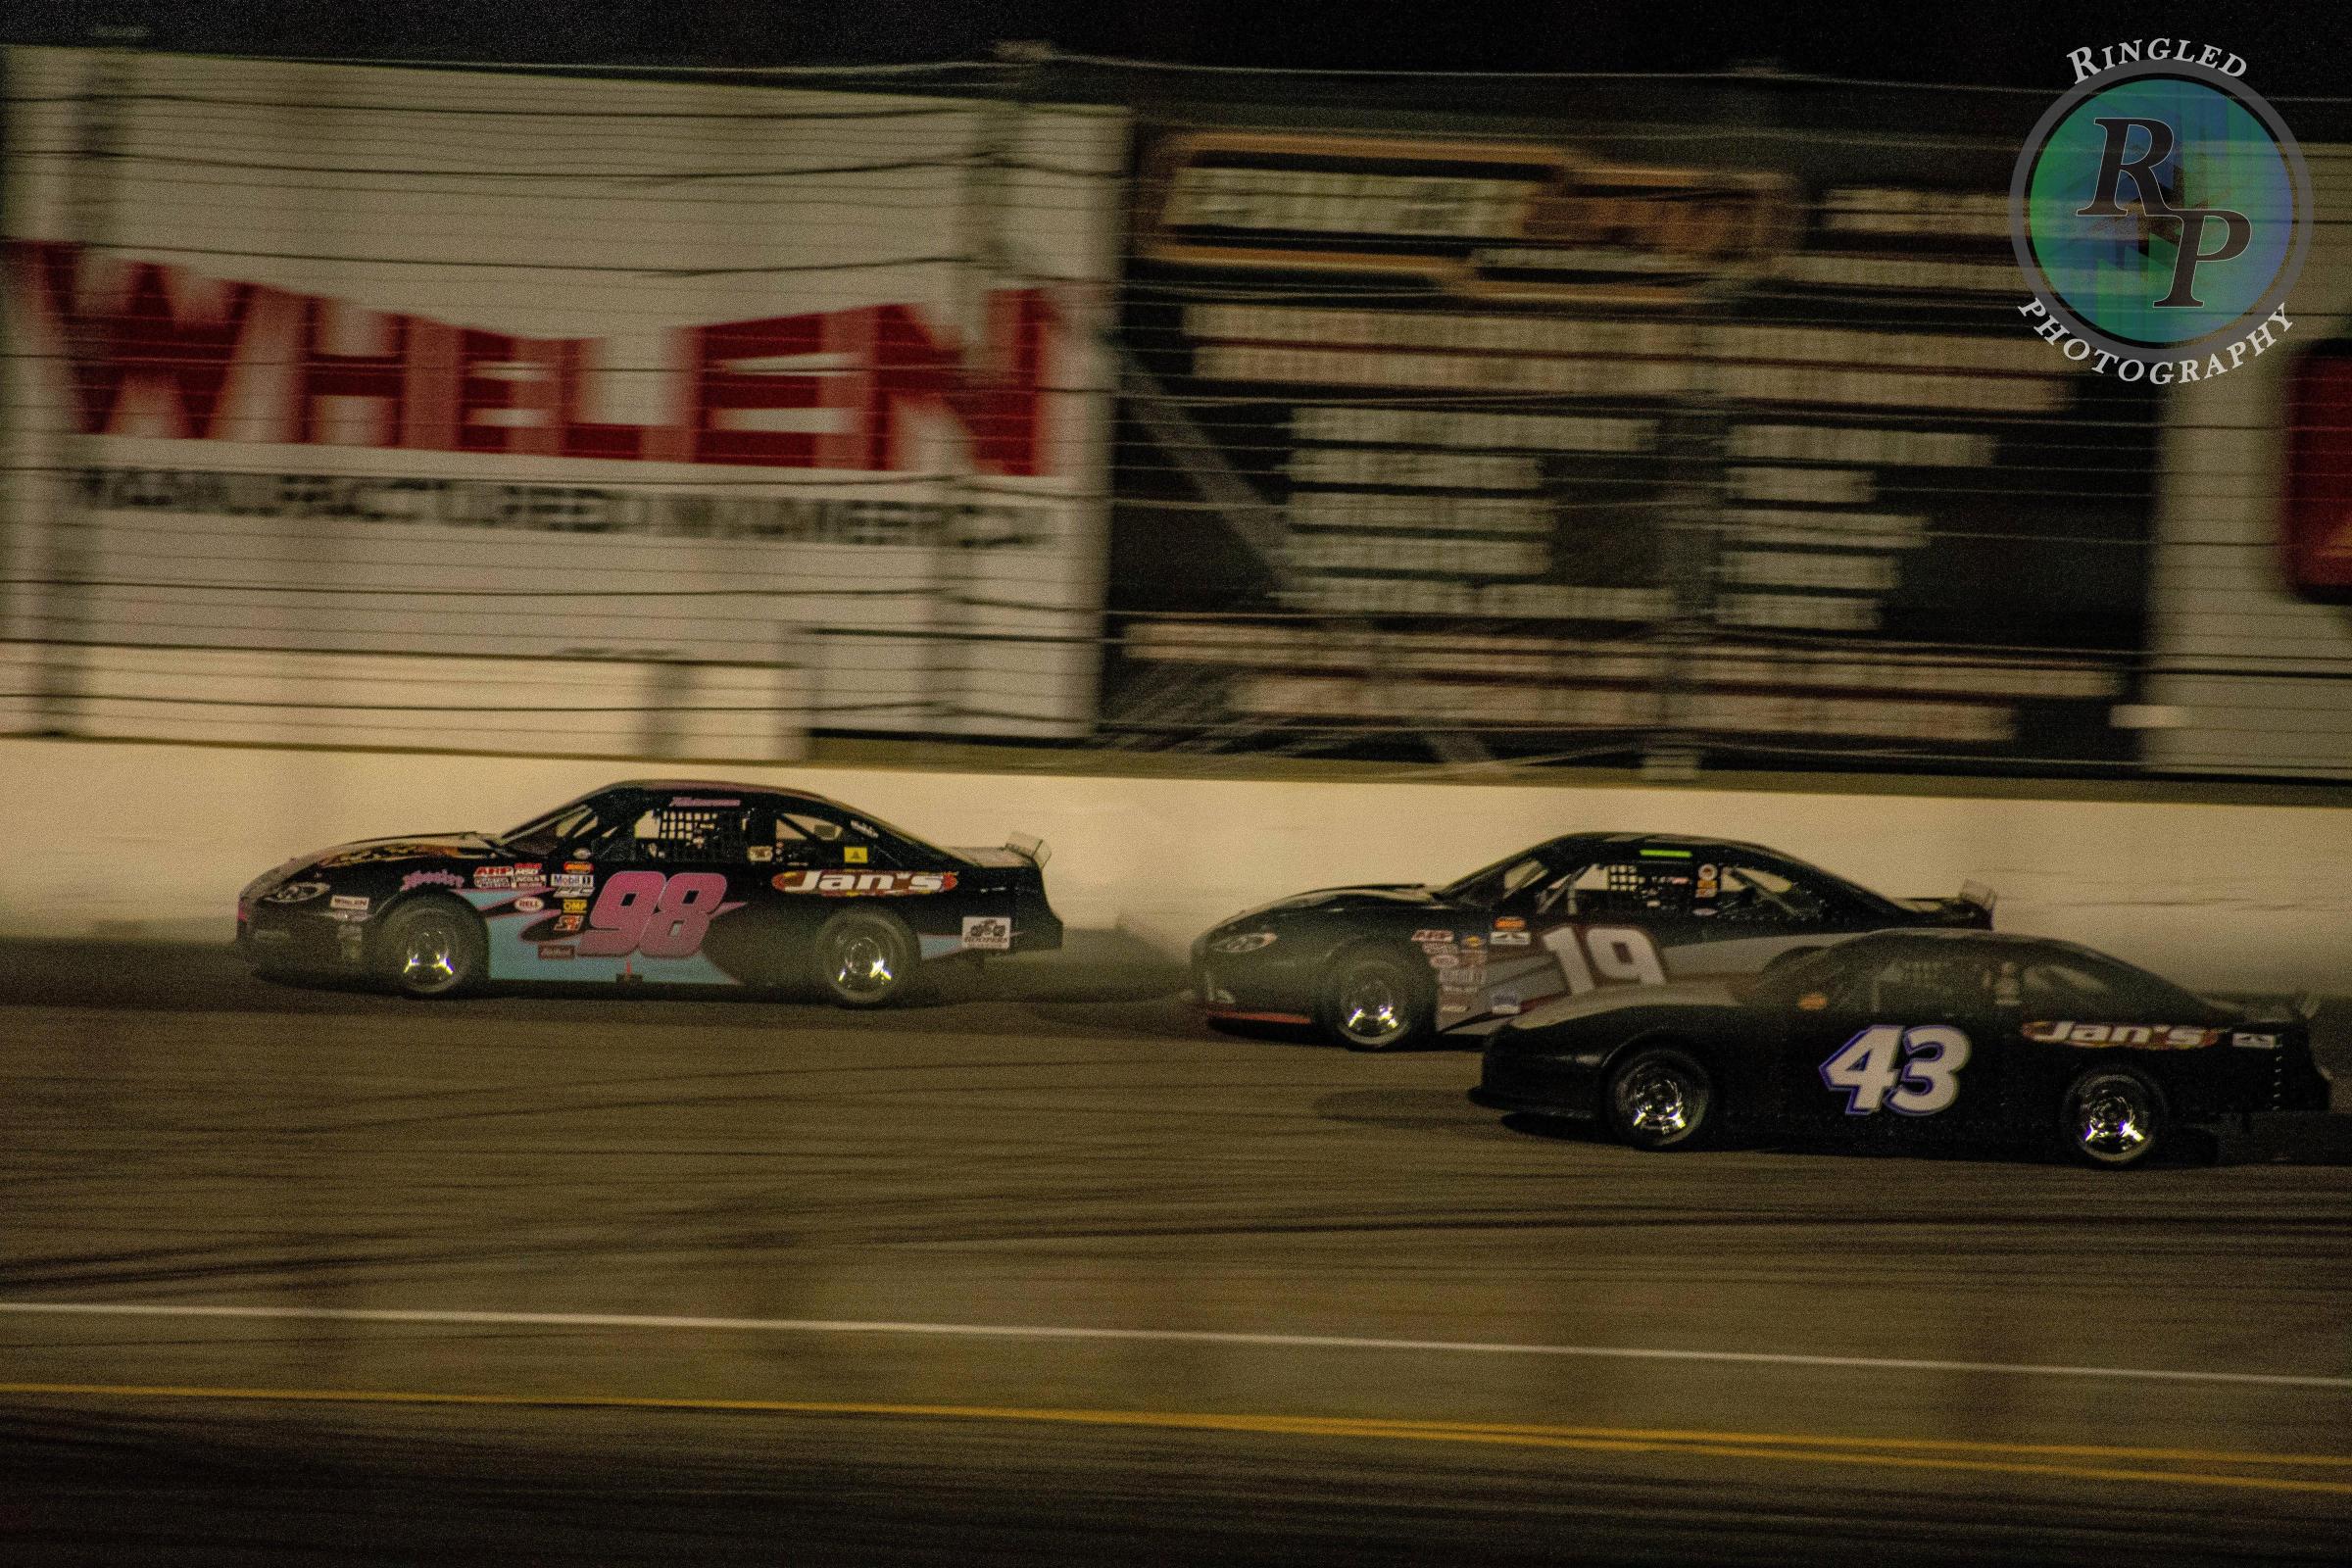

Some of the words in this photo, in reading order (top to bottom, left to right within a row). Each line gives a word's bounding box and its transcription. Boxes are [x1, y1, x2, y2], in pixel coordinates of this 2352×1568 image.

[4, 238, 1065, 478] WHELEN
[572, 870, 727, 957] 98
[784, 870, 944, 893] Jan's
[1543, 925, 1667, 995] 19
[1819, 1024, 1971, 1115] 43
[2031, 1021, 2204, 1046] Jan's
